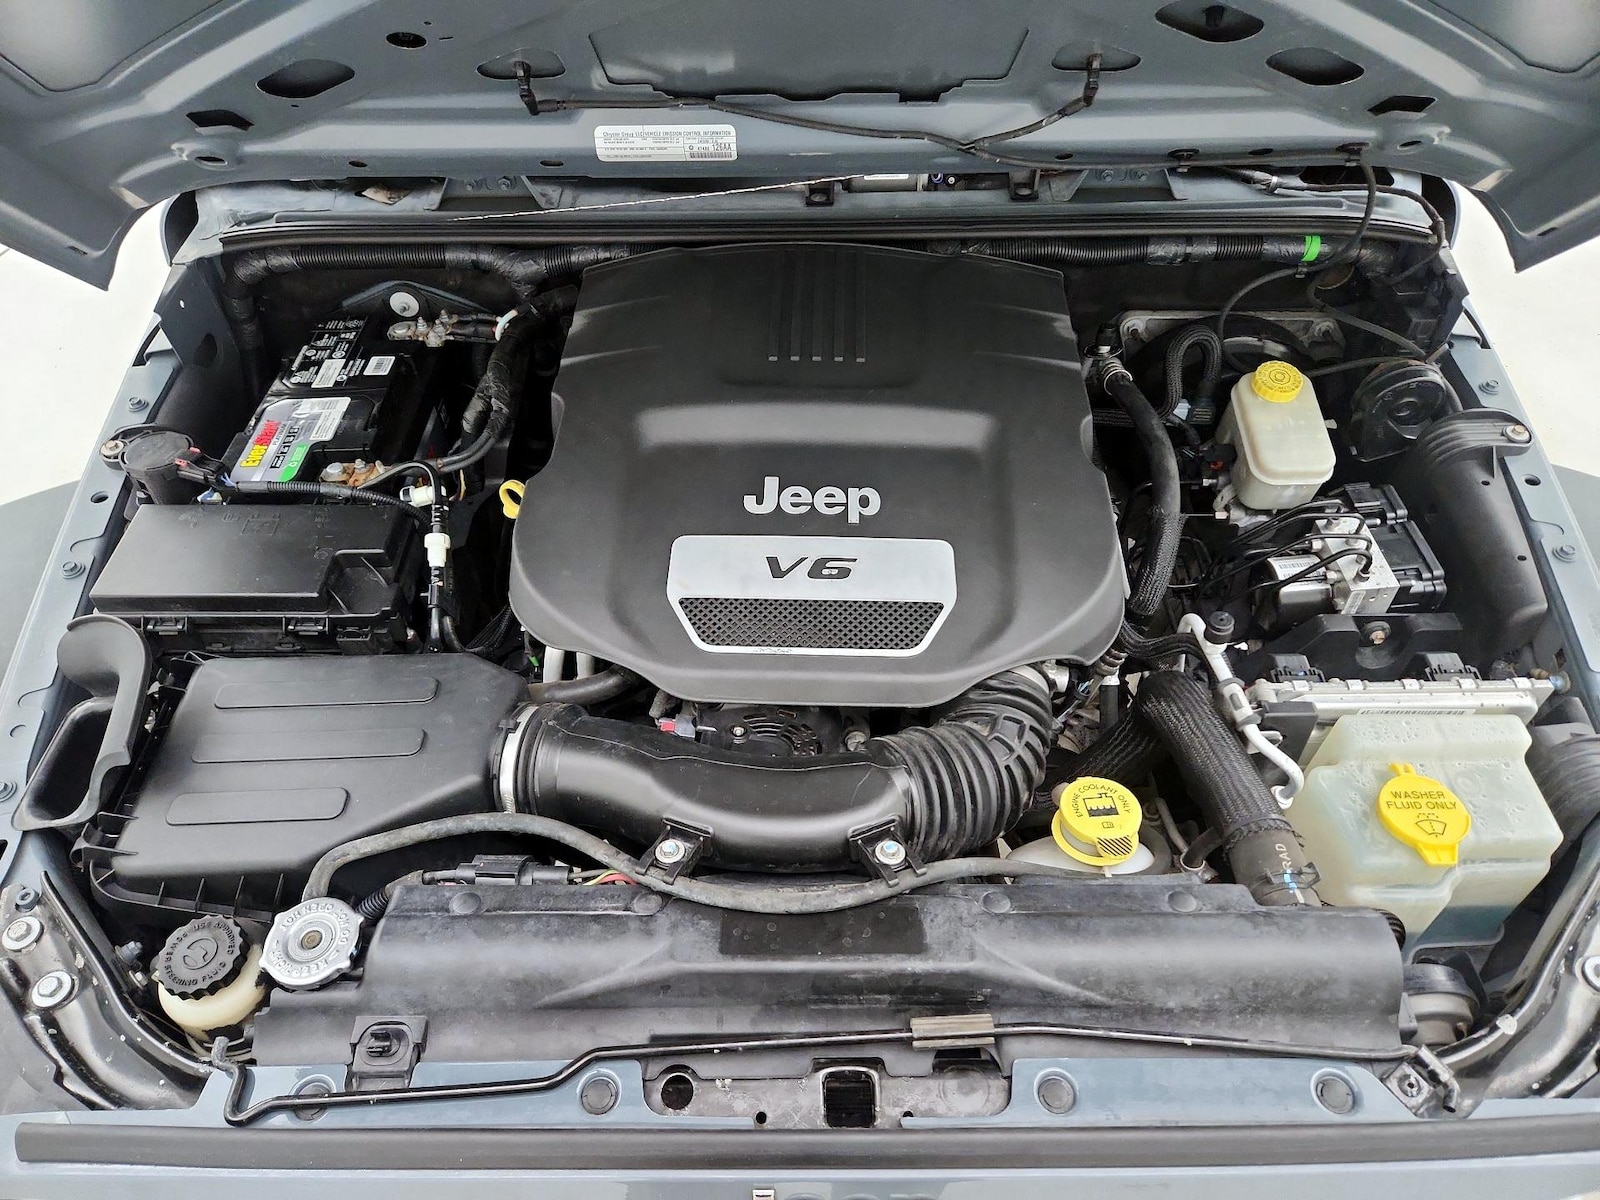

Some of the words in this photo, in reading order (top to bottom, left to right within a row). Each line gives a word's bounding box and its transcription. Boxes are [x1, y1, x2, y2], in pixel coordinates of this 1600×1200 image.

[240, 419, 281, 467] EverStart
[743, 476, 881, 524] Jeep
[766, 556, 858, 580] V6
[1072, 793, 1083, 817] ENGINE
[1079, 784, 1117, 794] COOLANT
[1118, 795, 1131, 813] ONLY
[1386, 801, 1423, 810] FLUID
[1425, 801, 1457, 810] ONLY
[1390, 790, 1446, 799] WASHER
[303, 902, 334, 913] OPEN
[280, 911, 301, 931] HOT
[192, 921, 212, 932] USE
[213, 922, 236, 955] APPROVED
